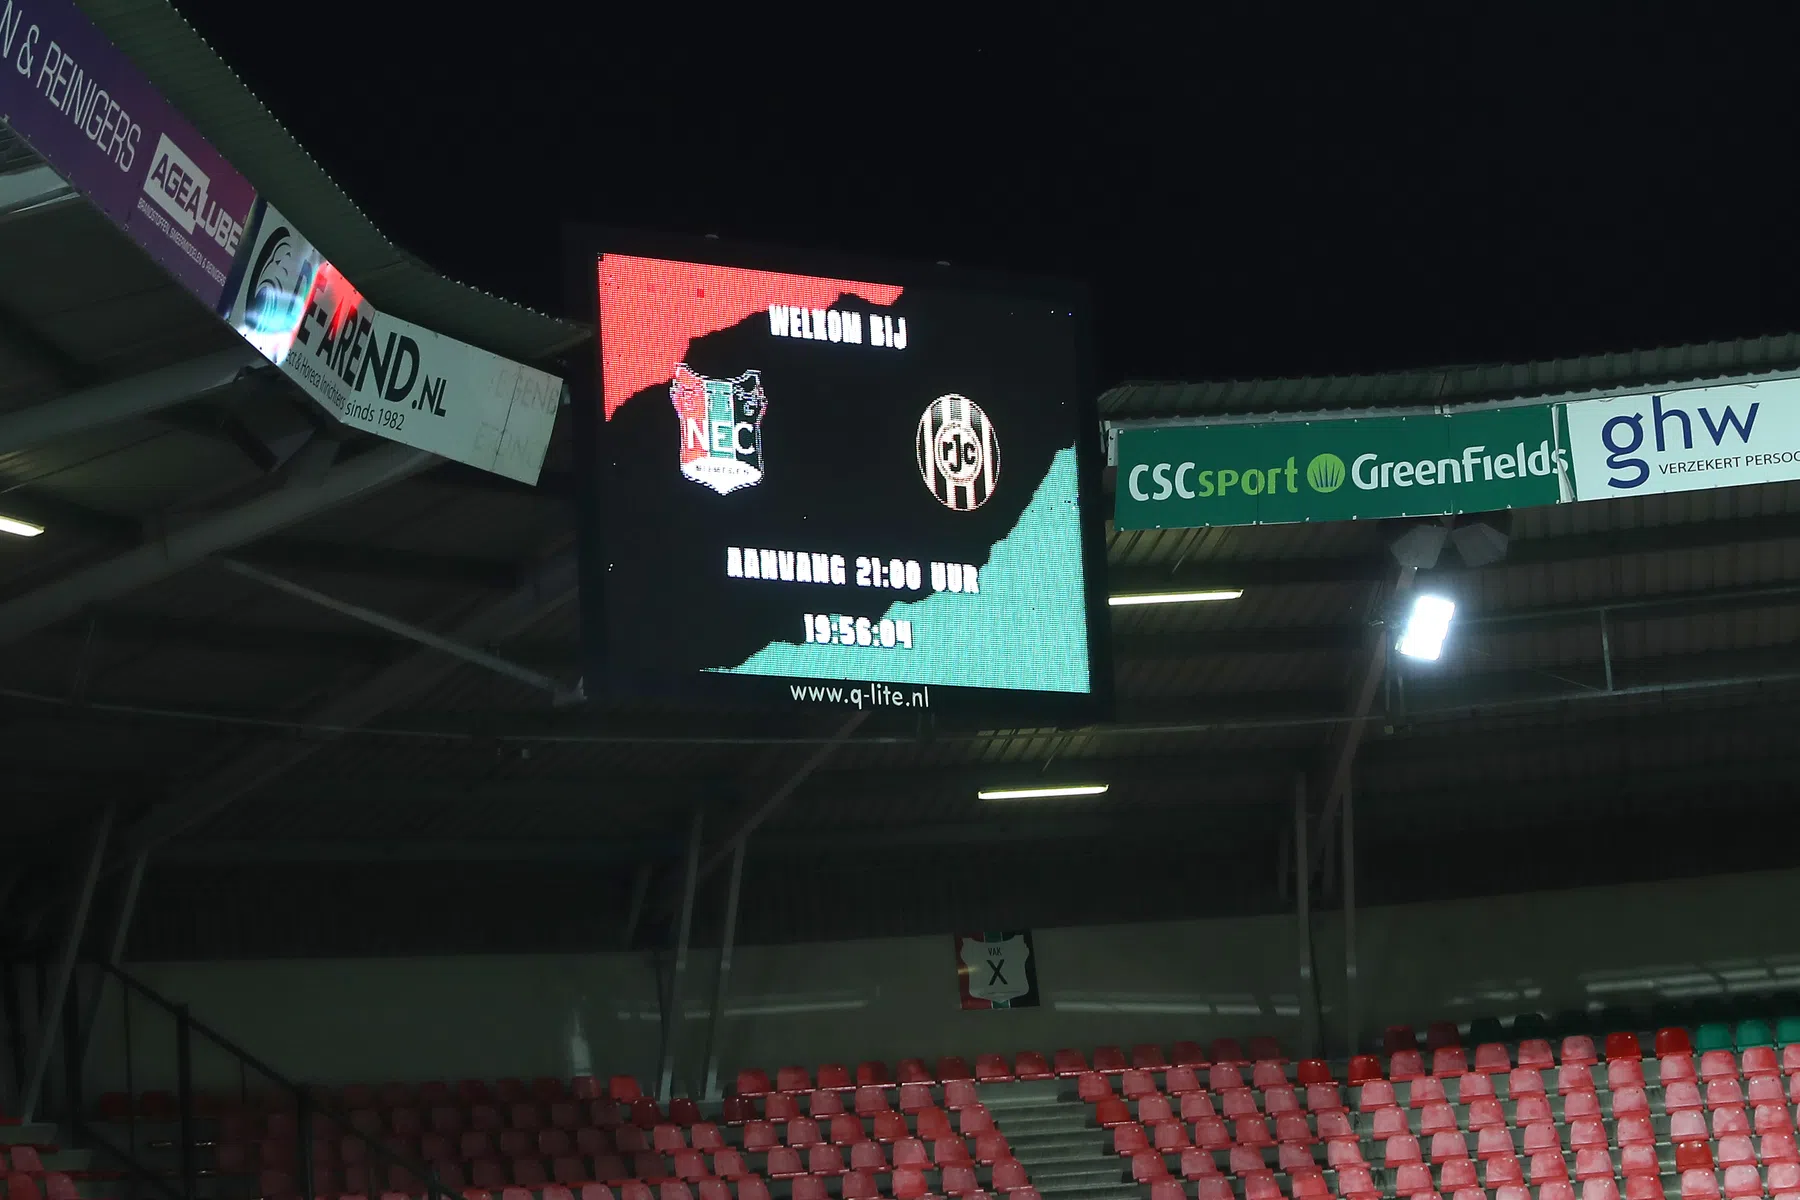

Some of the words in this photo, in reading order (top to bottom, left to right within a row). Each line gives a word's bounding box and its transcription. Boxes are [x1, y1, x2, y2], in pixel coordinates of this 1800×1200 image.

[16, 24, 40, 79] &
[36, 41, 142, 173] REINIGERS
[150, 153, 244, 257] AGEALUBE
[768, 303, 863, 344] WELKOM
[869, 313, 907, 350] BIJ
[300, 356, 322, 388] Horeca
[344, 400, 374, 422] sinds
[377, 408, 406, 431] 1982
[685, 418, 756, 455] NEC
[1601, 395, 1761, 490] ghw
[1351, 439, 1569, 491] GreenFields
[1658, 456, 1742, 475] VERZEKERT
[726, 546, 846, 585] AANVANG
[855, 556, 922, 591] 21:00
[930, 561, 981, 594] UUR
[803, 612, 914, 650] 19:56:04
[790, 682, 929, 710] www.q-lite.nl
[986, 959, 1009, 986] X
[988, 947, 1002, 956] VAK
